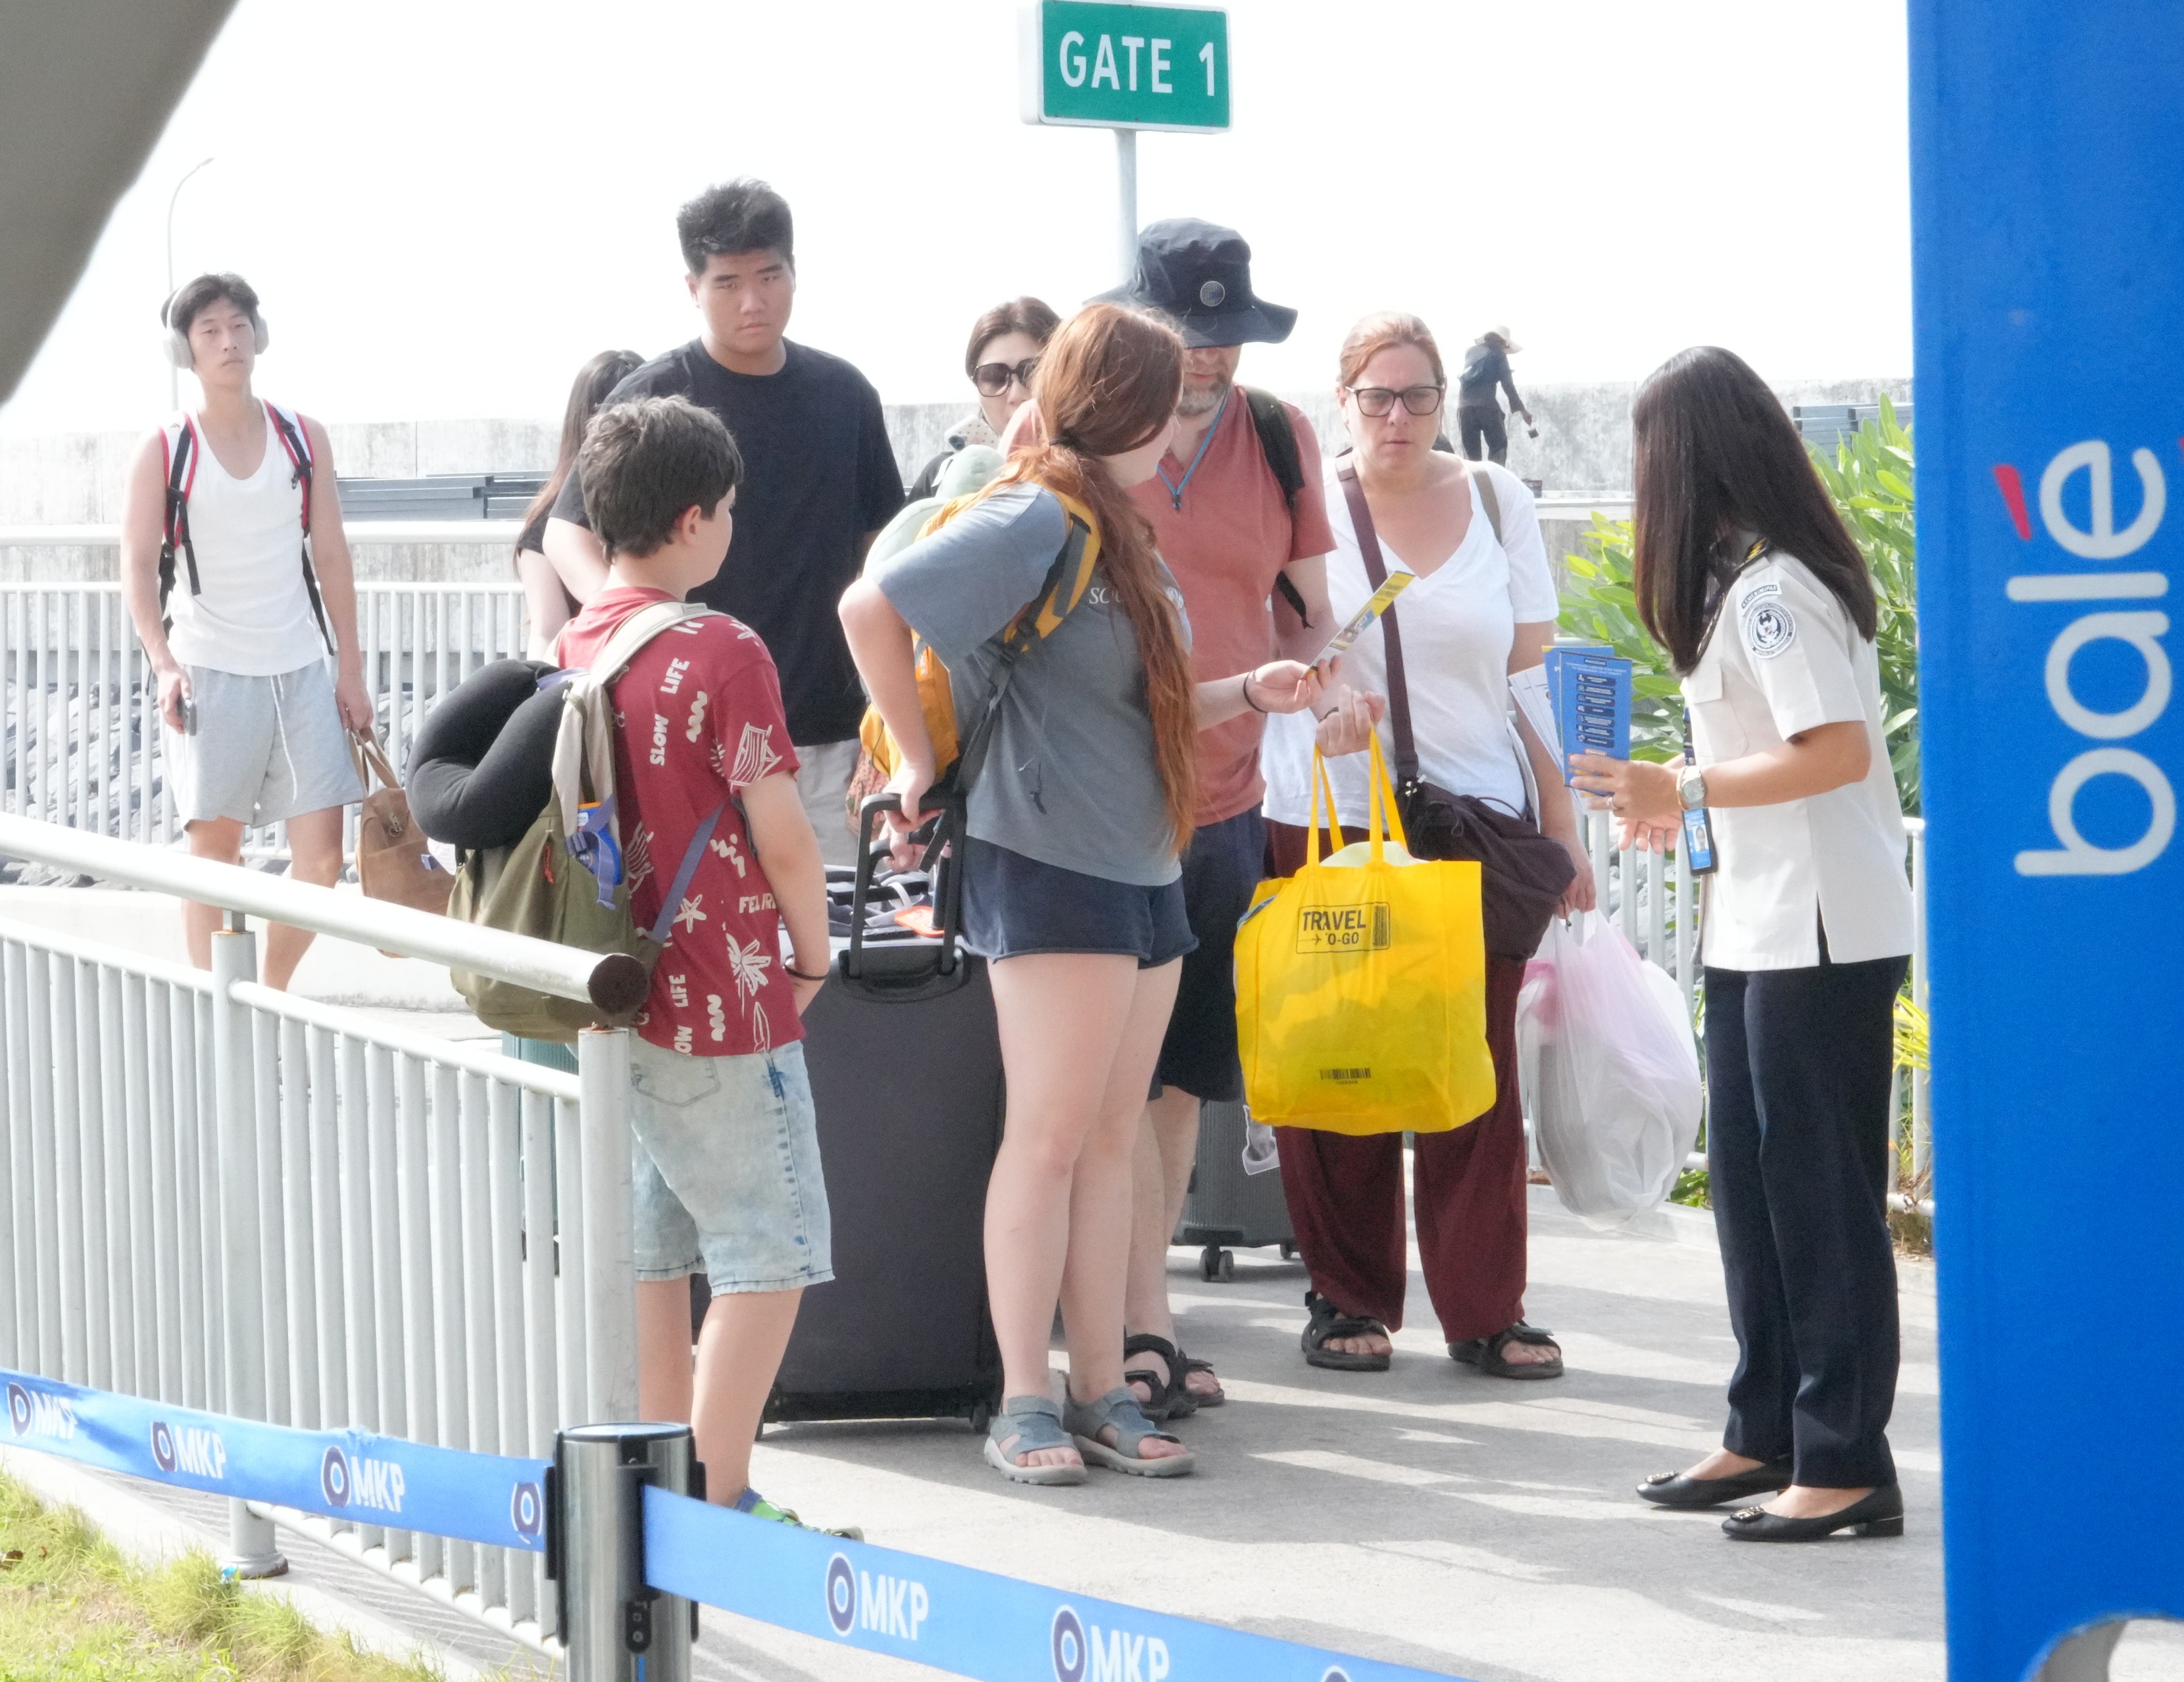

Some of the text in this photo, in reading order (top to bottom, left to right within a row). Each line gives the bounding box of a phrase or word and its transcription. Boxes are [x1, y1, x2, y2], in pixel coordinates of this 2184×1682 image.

[1059, 30, 1216, 97] GATE 1
[1993, 439, 2177, 876] balé
[650, 713, 669, 766] SLOW
[660, 658, 689, 695] LIFE
[1303, 910, 1366, 931] TRAVEL
[1326, 932, 1360, 945] O-GO
[668, 974, 688, 1007] LIFE
[174, 1425, 227, 1479] MKP
[351, 1456, 405, 1513] MKP
[860, 1571, 930, 1641] MKP
[1091, 1625, 1170, 1682] MKP
